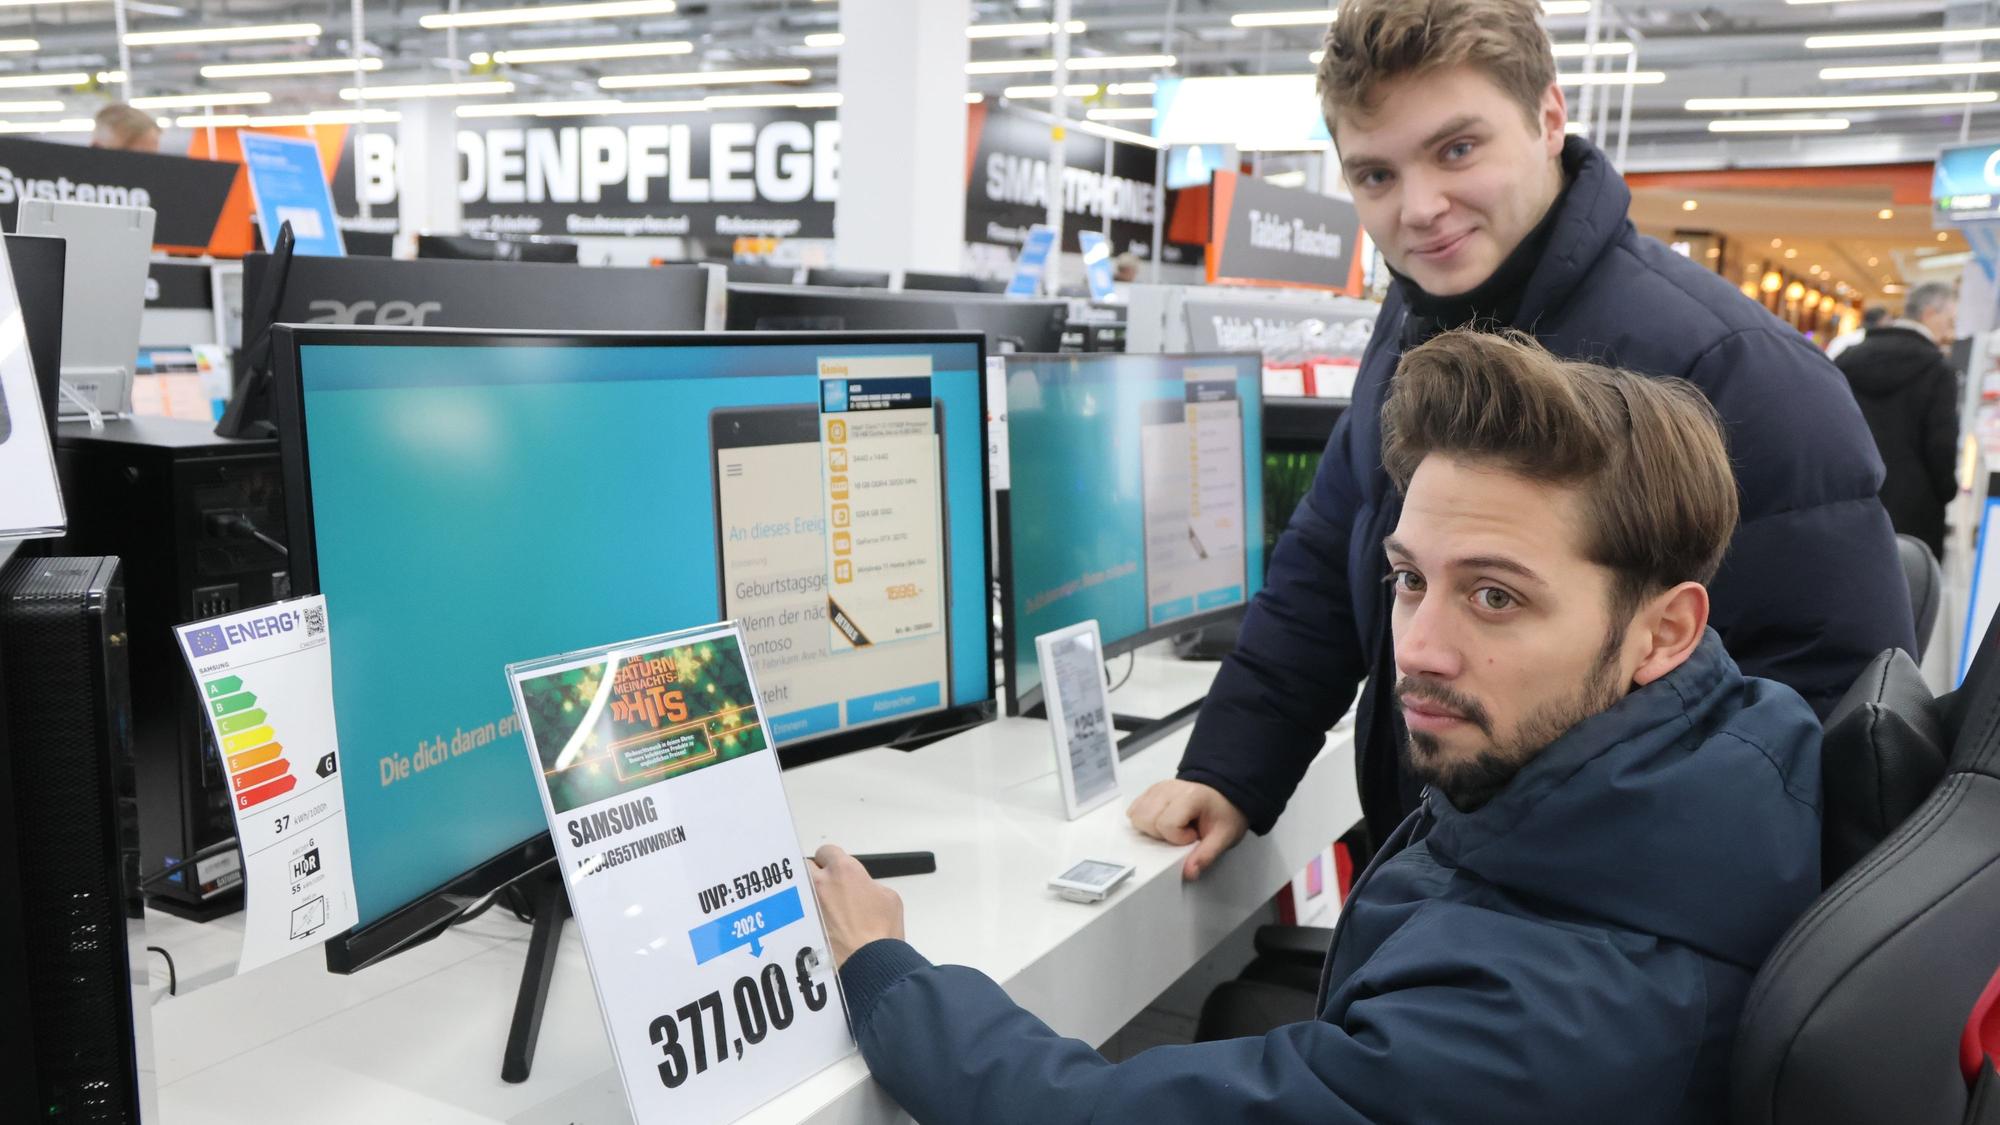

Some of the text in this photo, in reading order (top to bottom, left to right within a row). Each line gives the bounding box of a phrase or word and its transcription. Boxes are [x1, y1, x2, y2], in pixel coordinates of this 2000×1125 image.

[355, 120, 841, 205] BDENPFLEGE
[309, 299, 441, 325] acer
[728, 525, 747, 542] An
[750, 521, 791, 540] dieses
[224, 612, 294, 645] ENERG
[778, 609, 800, 626] der
[833, 612, 859, 641] DETAILS
[744, 636, 793, 658] ontoso
[198, 661, 230, 675] SAMSUNG
[613, 657, 677, 685] SATURN
[210, 684, 219, 694] A
[761, 684, 789, 704] teht
[216, 703, 224, 713] B
[222, 720, 229, 731] C
[231, 757, 333, 772] E G
[379, 752, 410, 787] Die
[412, 734, 449, 773] dich
[450, 721, 496, 757] daran
[236, 778, 243, 788] F
[240, 796, 248, 806] G
[274, 815, 290, 833] 37
[567, 796, 659, 848] SAMSUNG
[577, 825, 687, 877] 4G55TWWRXEN
[293, 855, 317, 879] HDR
[291, 884, 302, 895] 55
[698, 857, 794, 914] UVP: 579,00 €
[731, 912, 765, 939] -202 €
[648, 946, 828, 1089] 377,00 €
